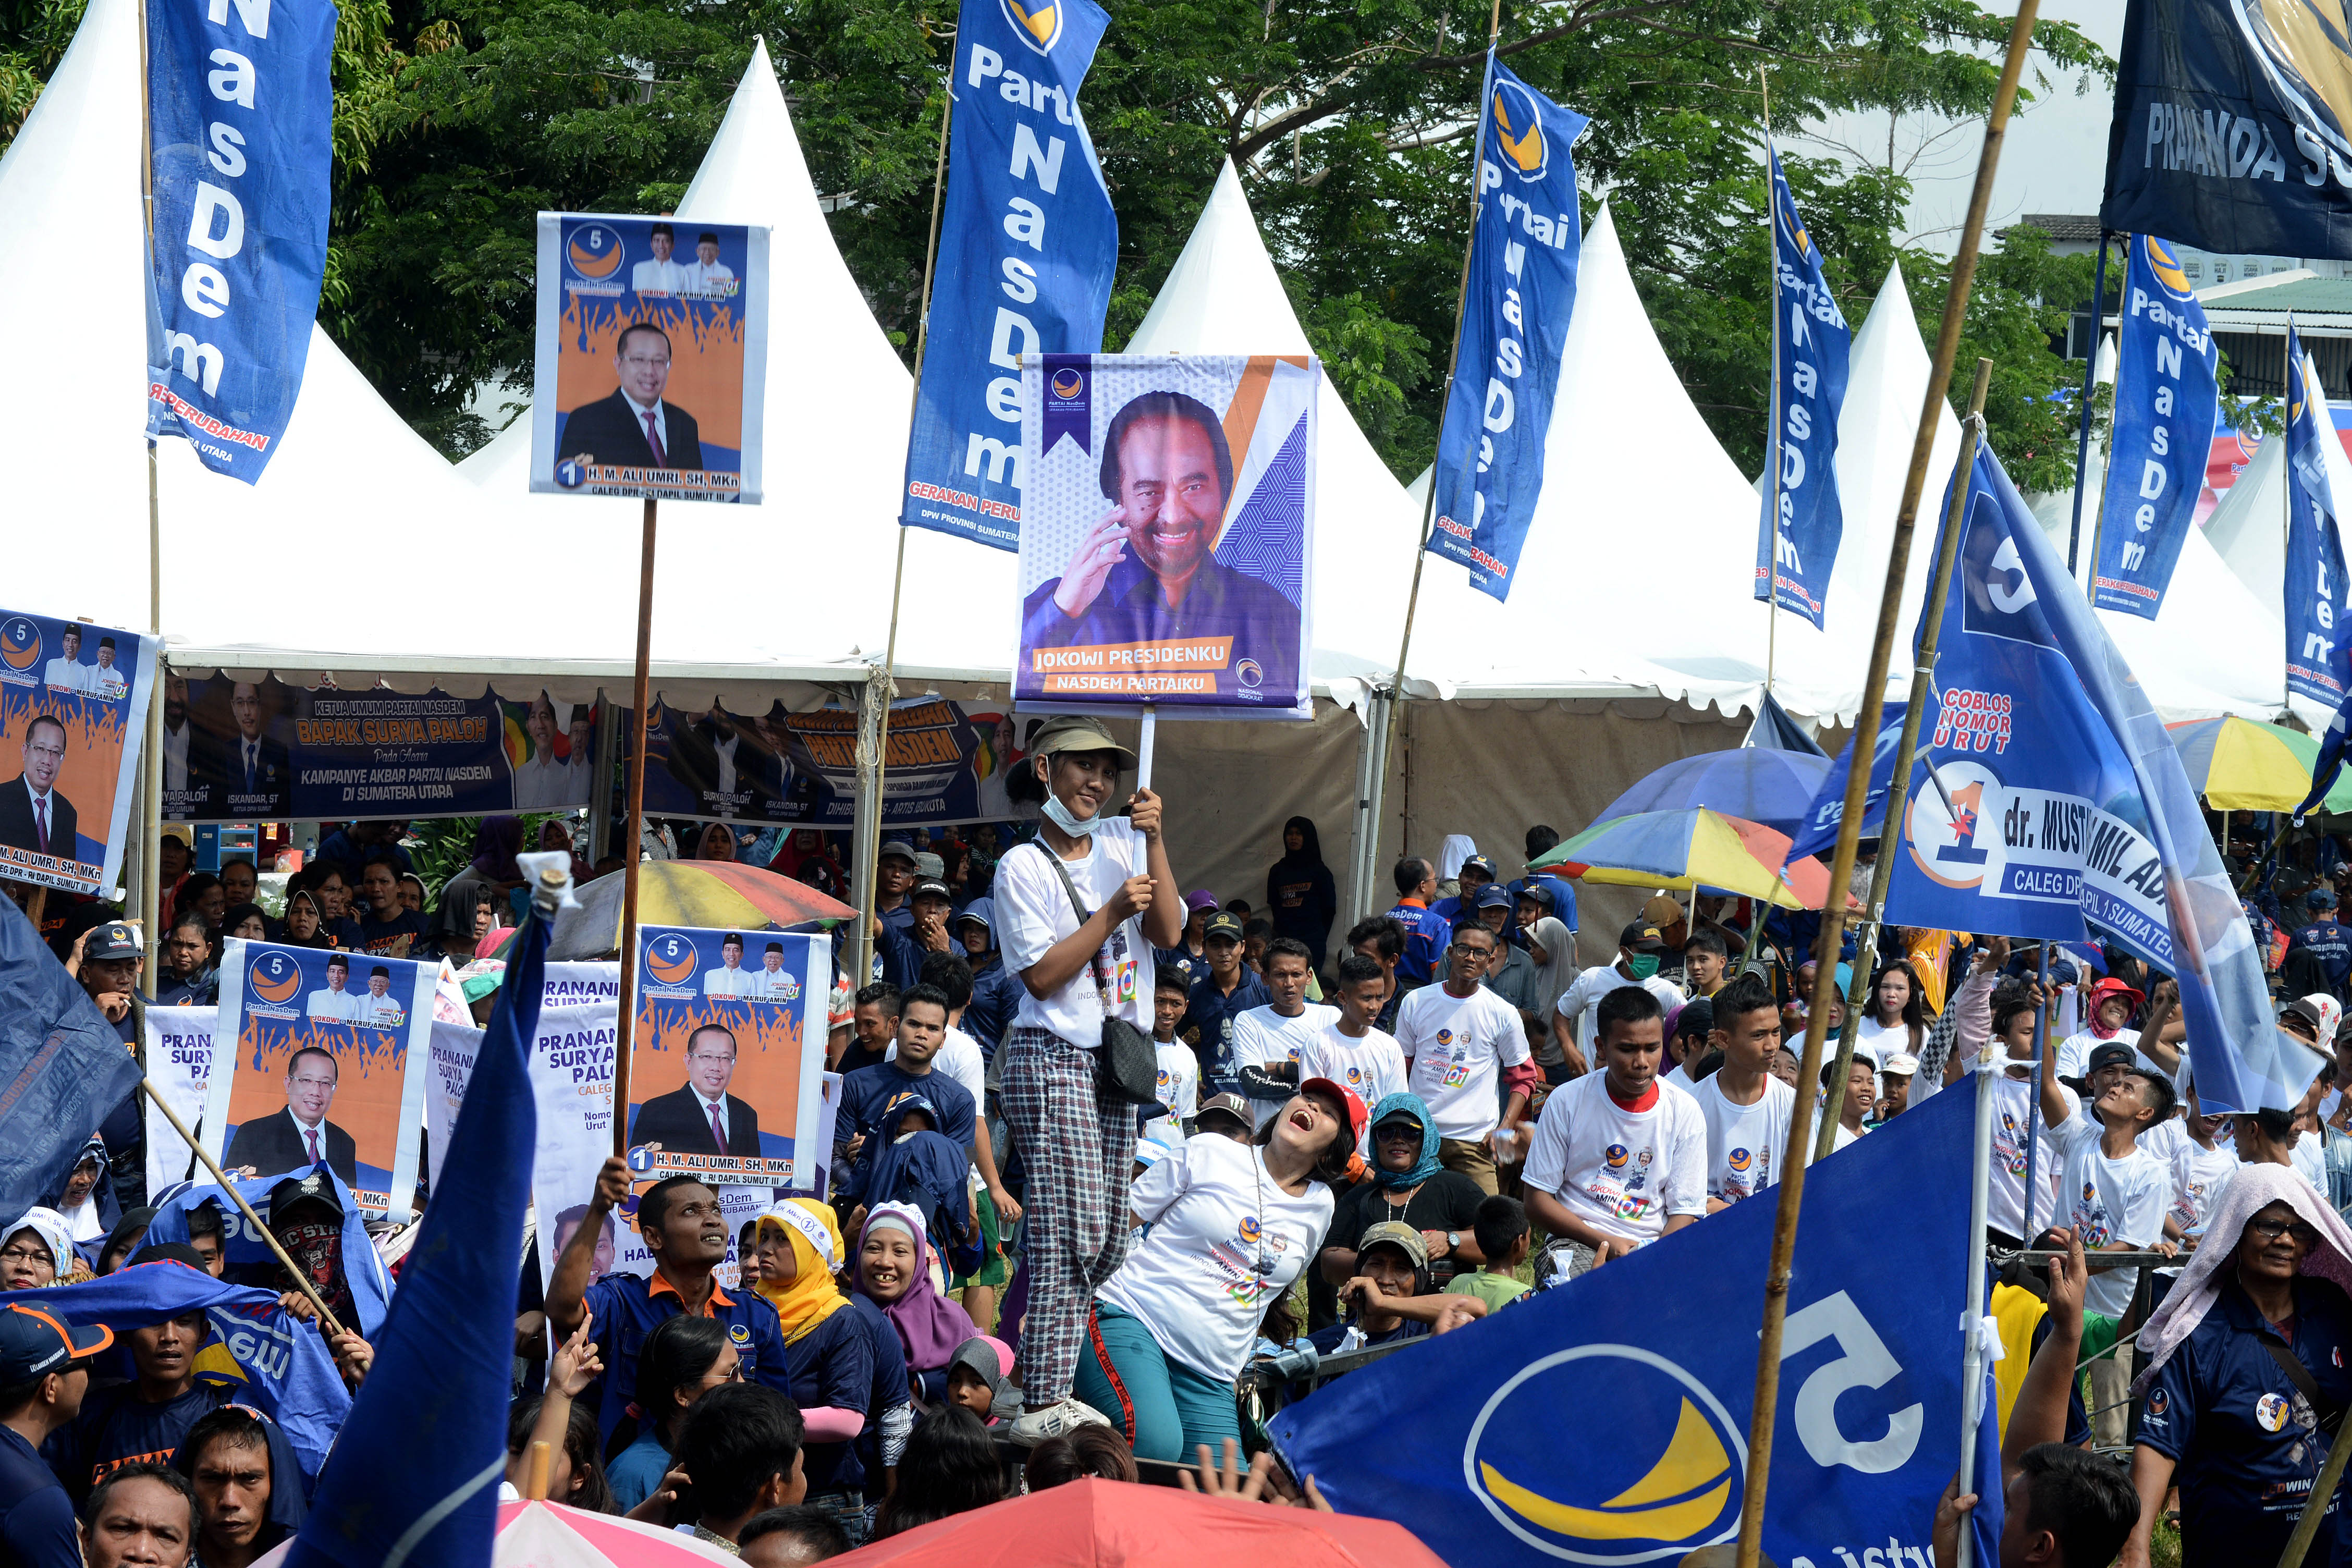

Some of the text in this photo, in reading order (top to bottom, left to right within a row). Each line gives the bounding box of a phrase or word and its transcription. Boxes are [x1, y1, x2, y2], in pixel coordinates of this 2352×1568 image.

[2144, 102, 2286, 182] PRANANDA
[590, 229, 602, 249] 5
[704, 292, 725, 302] AMIN
[2132, 286, 2209, 357] Partai
[167, 391, 271, 452] PERUBAHAN
[201, 444, 232, 462] UTARA
[2121, 335, 2183, 572] NasDem
[562, 461, 576, 486] 1
[587, 466, 601, 481] H.
[604, 467, 619, 481] M.
[621, 468, 643, 484] ALI
[685, 471, 707, 487] SH,
[710, 472, 739, 488] MKn
[592, 487, 619, 496] CALEG
[657, 489, 680, 499] DAPIL
[716, 493, 725, 501] III
[909, 481, 978, 511] GERAKAN
[922, 509, 939, 520] DPW
[941, 513, 976, 530] PROVINSI
[1444, 541, 1456, 551] DPW
[16, 624, 26, 641] 5
[1037, 646, 1224, 669] JOKOWI PRESIDENKU
[14, 671, 38, 682] NasDem
[1057, 676, 1204, 691] NASDEM PARTAIKU
[49, 684, 114, 703] JOKOWI MA'RUF AMIN
[1943, 688, 2012, 715] COBLOS
[315, 700, 466, 716] KETUA UMUM PARTAI NASDEM
[1937, 707, 2012, 736] NOMOR
[296, 717, 488, 745] BAPAK SURYA PALOH
[1933, 727, 2011, 754] URUT
[374, 748, 428, 764] Pada Acara
[301, 766, 492, 785] KAMPANYE AKBAR PARTAI NASDEM
[177, 791, 208, 802] PALOH
[228, 794, 279, 804] ISKANDAR, ST
[342, 784, 454, 802] DI SUMATERA UTARA
[703, 790, 751, 805] SURYA PALOH
[765, 801, 799, 811] ISKANDAR,
[891, 798, 946, 815] ARTIS IBUKOTA
[1936, 780, 1988, 865] 1
[2004, 797, 2034, 849] dr.
[11, 850, 29, 864] ALI
[31, 854, 58, 871] UMRI.
[60, 861, 77, 877] SH,
[79, 865, 102, 880] MKn
[9, 867, 23, 877] DPR
[36, 873, 55, 885] DAPIL
[57, 878, 80, 890] SUMUT
[2014, 870, 2062, 895] CALEG
[667, 940, 678, 956] 5
[271, 958, 283, 975] 5
[666, 986, 696, 996] NasDem
[788, 985, 800, 996] 01
[246, 1002, 300, 1015] Partai NasDem
[392, 1011, 406, 1022] 01
[313, 1015, 340, 1024] JOKOWI
[346, 1019, 372, 1028] MA'RUF
[432, 1046, 474, 1070] PRANAND
[549, 1046, 614, 1069] SURYA
[1426, 1059, 1450, 1068] JOKOWI
[438, 1063, 463, 1083] SURYA
[1224, 1059, 1236, 1077] 4
[1448, 1069, 1468, 1085] 01
[578, 1083, 611, 1096] CALEG
[585, 1121, 606, 1131] Urut
[632, 1148, 646, 1170] 1
[656, 1154, 793, 1173] H. M. ALI UMRI. SH, MKn
[1598, 1169, 1621, 1182] NasDem
[1602, 1166, 1619, 1175] Partai
[718, 1174, 740, 1183] DAPIL
[742, 1175, 769, 1185] SUMUT
[771, 1177, 779, 1185] III
[1726, 1177, 1749, 1185] NasDem
[1587, 1184, 1621, 1196] JOKOWI
[362, 1192, 389, 1207] MKn
[1595, 1194, 1618, 1204] AMIN
[787, 1209, 801, 1221] Mkn
[1619, 1200, 1646, 1219] 01
[2174, 1199, 2196, 1217] JOKOWI
[2176, 1207, 2191, 1221] AMIN
[1225, 1239, 1250, 1261] NasDem
[1215, 1261, 1241, 1279] AMIN
[2155, 1392, 2162, 1400] 5
[2268, 1478, 2311, 1494] EDWIN
